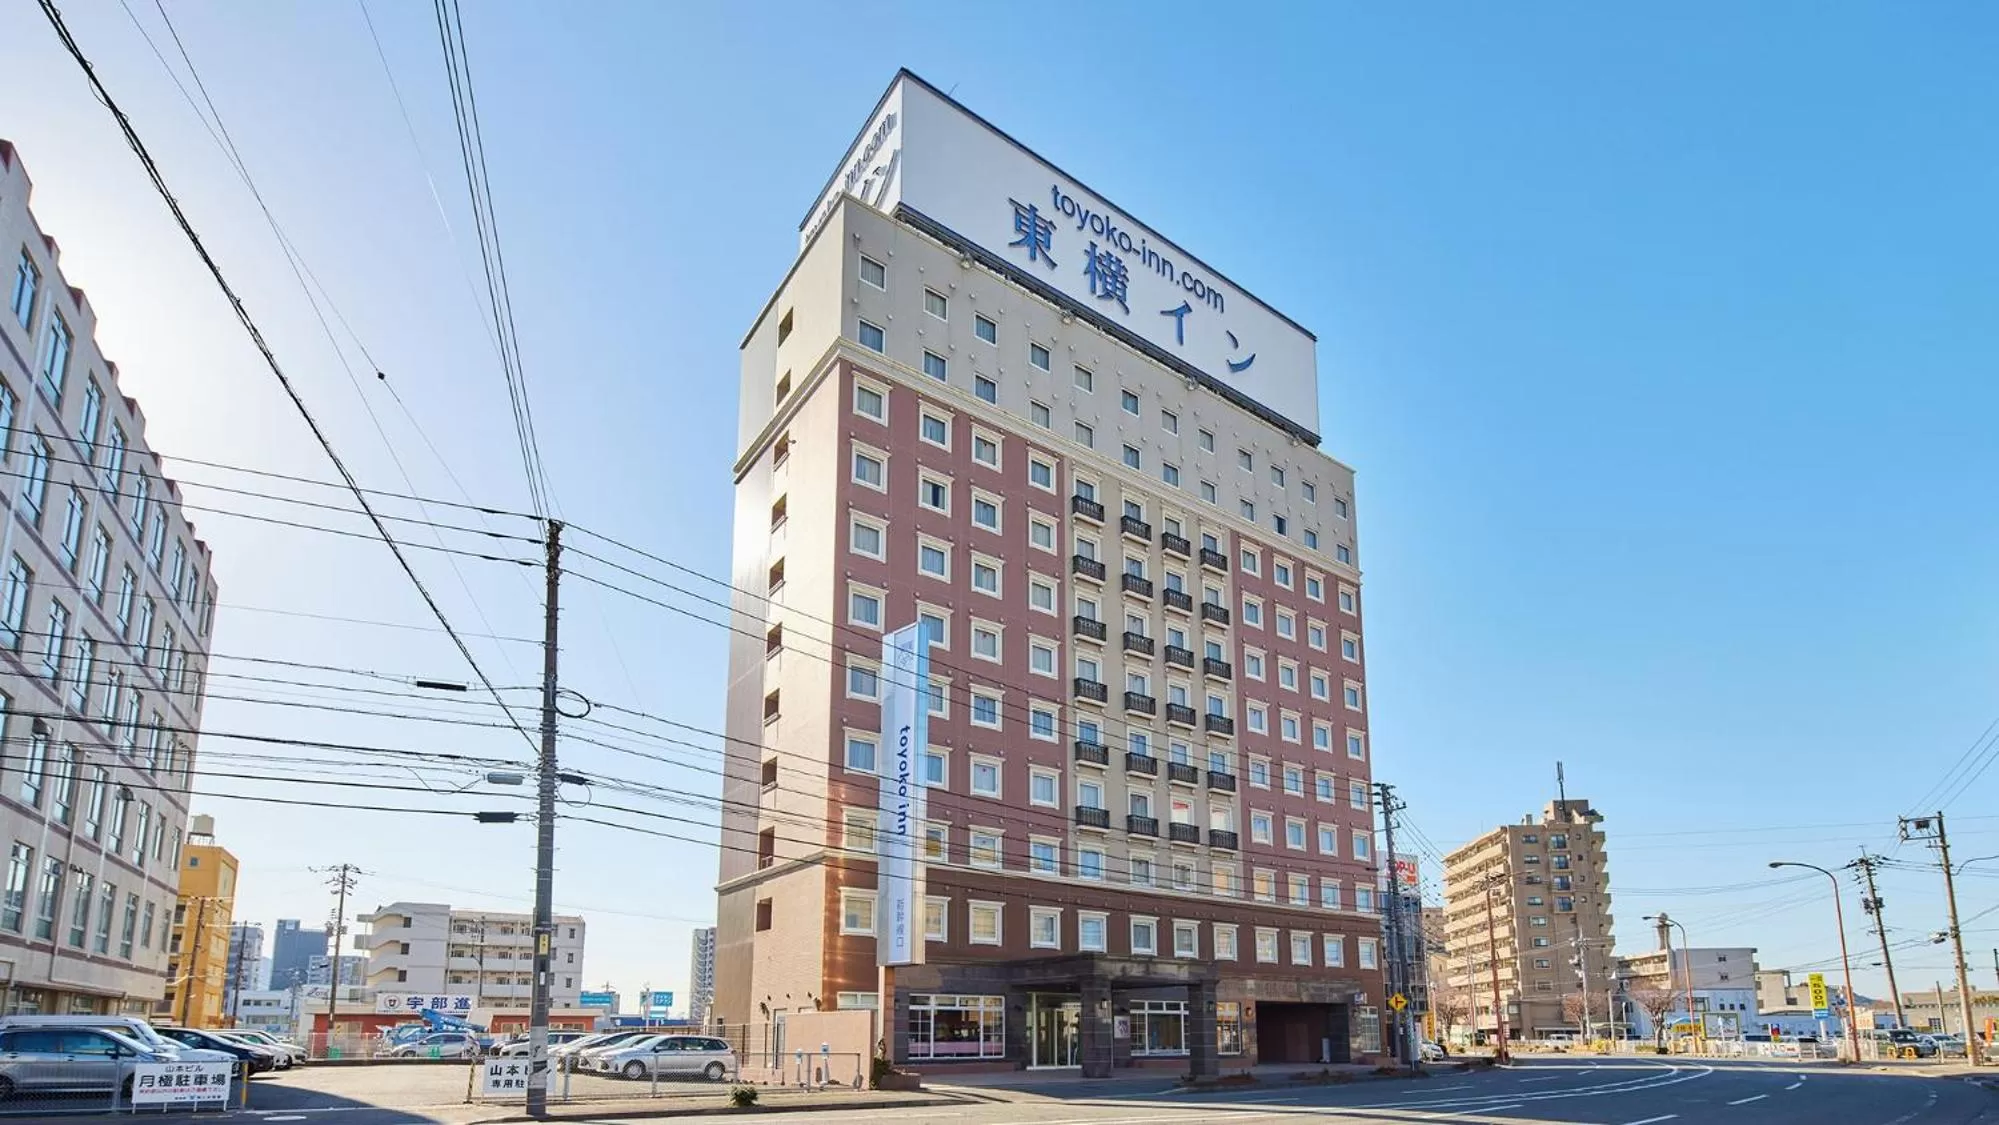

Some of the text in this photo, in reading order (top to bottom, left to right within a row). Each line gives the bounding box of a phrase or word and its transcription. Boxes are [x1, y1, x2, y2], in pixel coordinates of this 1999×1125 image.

[1008, 196, 1256, 373] 東横イン
[1051, 184, 1225, 314] toyoko-inn.com
[897, 724, 910, 835] toyoko inn
[139, 1074, 226, 1088] 月極駐車場
[165, 1064, 203, 1073] 山本ビル
